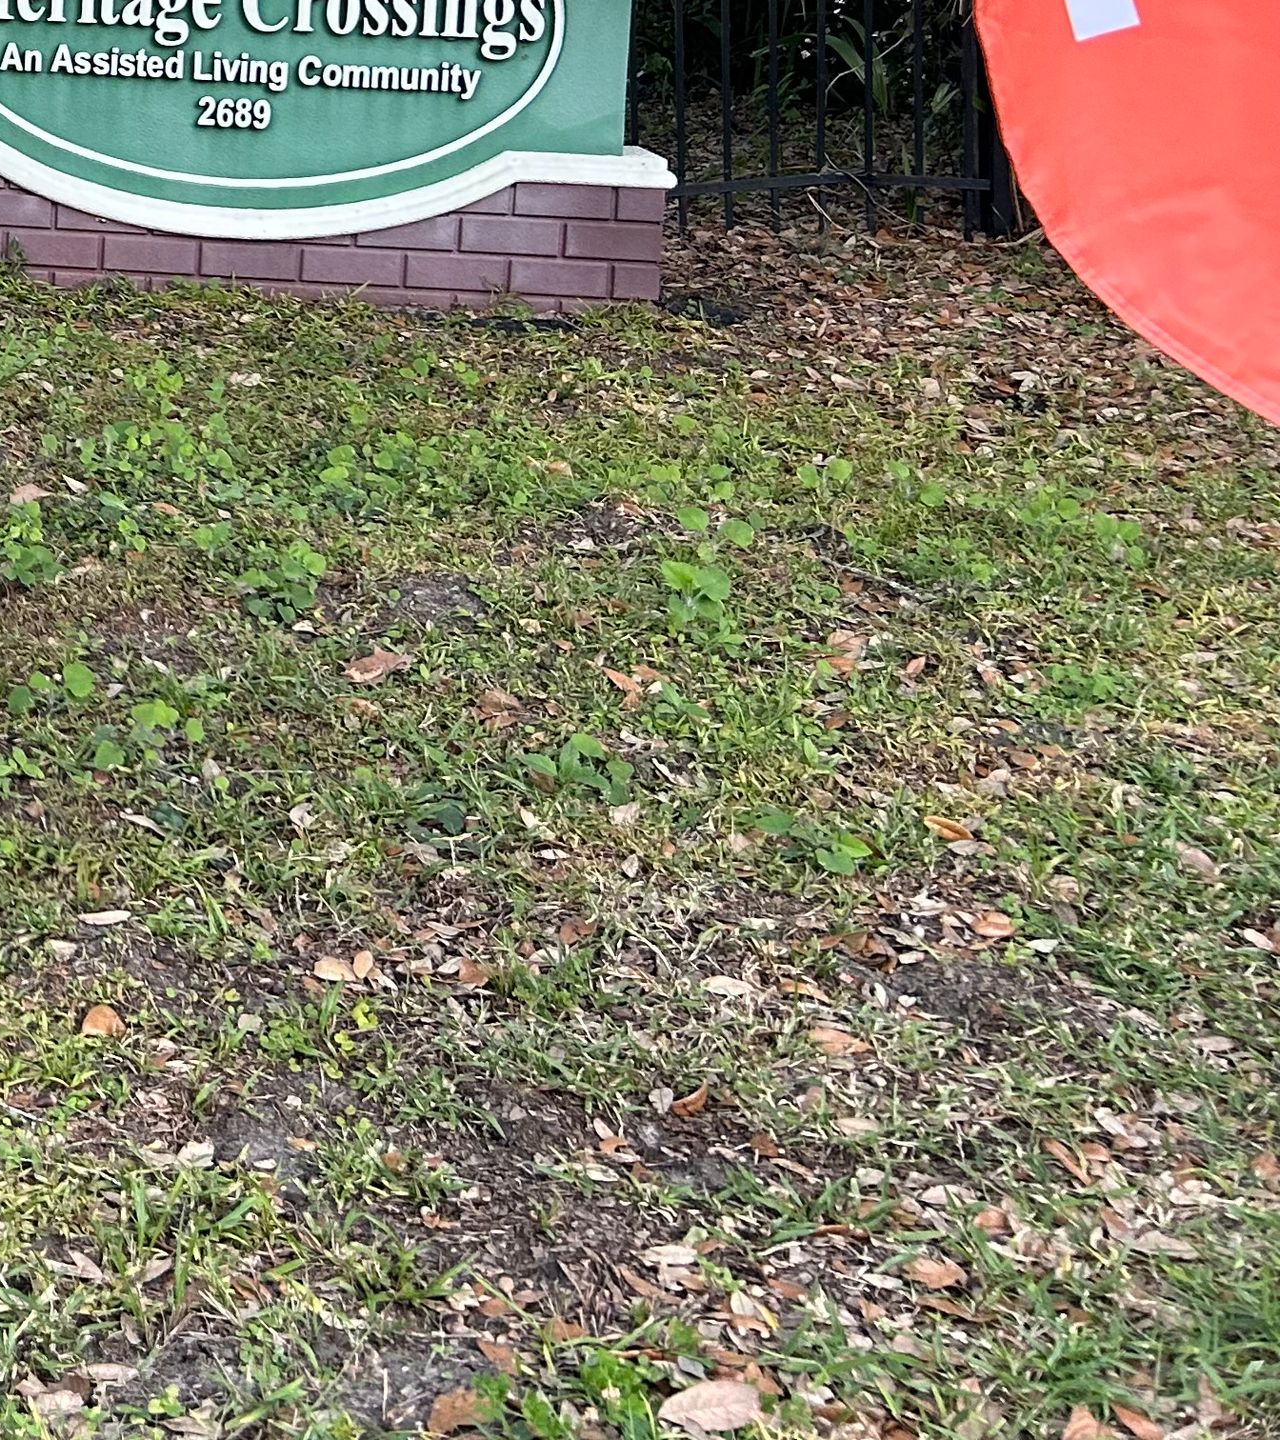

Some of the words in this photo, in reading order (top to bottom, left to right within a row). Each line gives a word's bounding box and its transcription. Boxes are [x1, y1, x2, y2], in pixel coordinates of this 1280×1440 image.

[0, 42, 42, 72] An
[50, 43, 184, 79] Assisted
[193, 50, 289, 92] Living
[298, 55, 482, 100] Community
[197, 95, 272, 130] 2689
